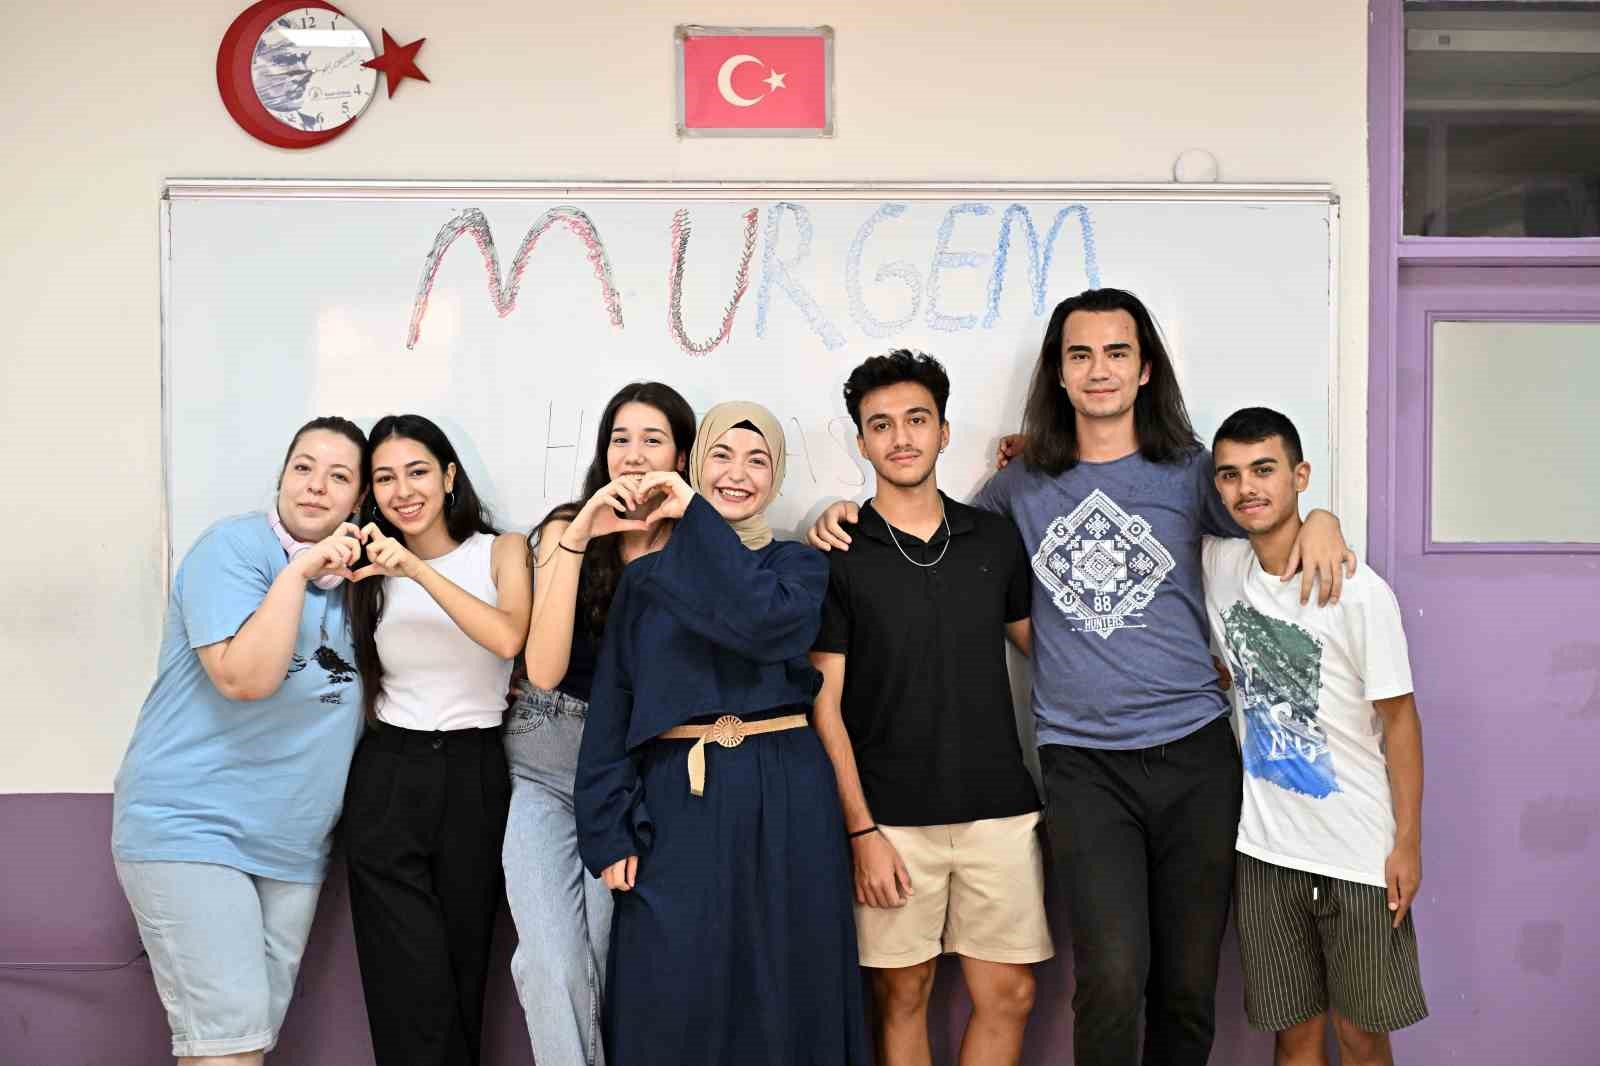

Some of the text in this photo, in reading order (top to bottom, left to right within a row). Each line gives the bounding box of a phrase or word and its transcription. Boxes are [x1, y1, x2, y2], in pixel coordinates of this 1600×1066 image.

[301, 16, 316, 29] 12
[1094, 595, 1112, 612] 88
[1084, 615, 1125, 631] HUNTERS
